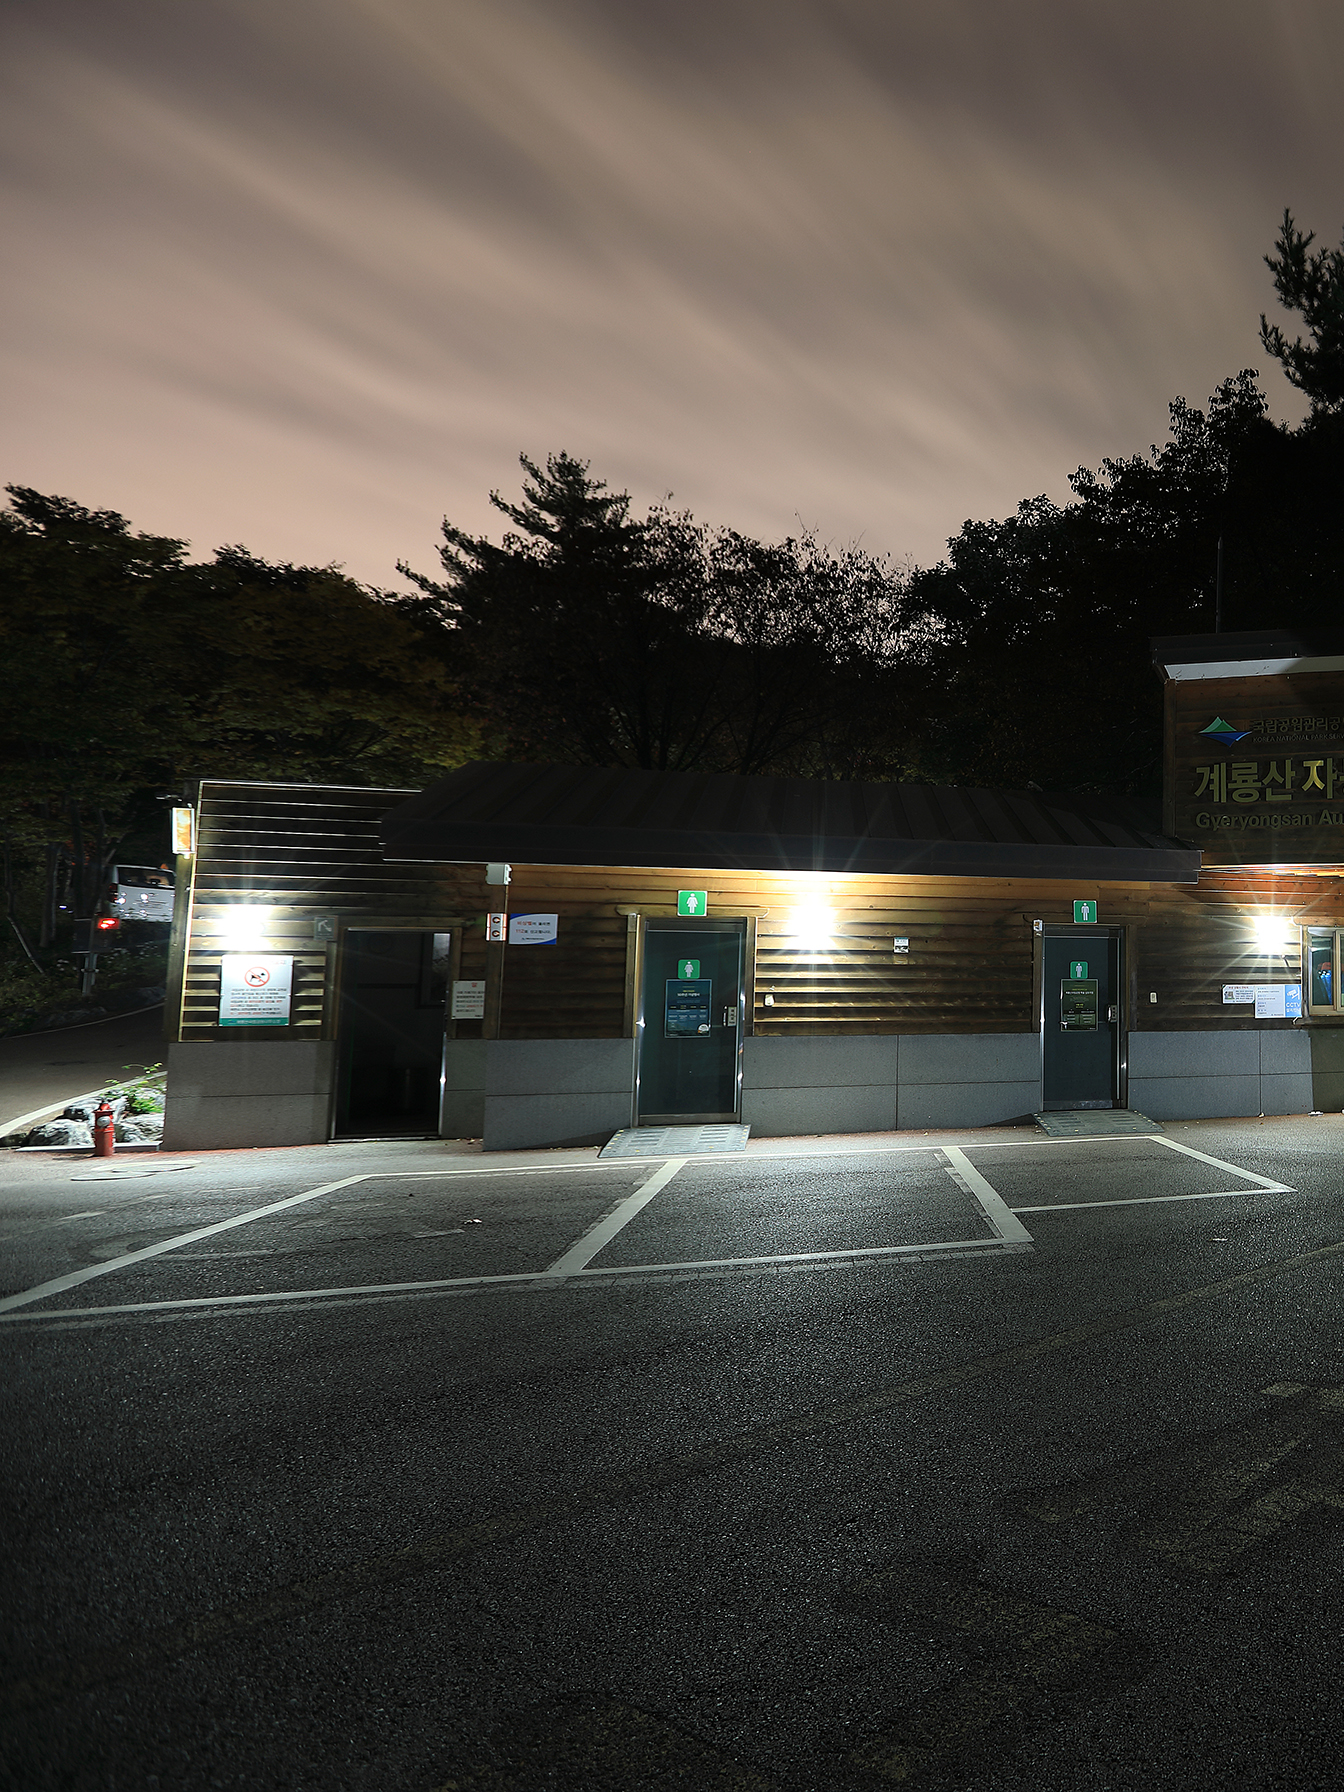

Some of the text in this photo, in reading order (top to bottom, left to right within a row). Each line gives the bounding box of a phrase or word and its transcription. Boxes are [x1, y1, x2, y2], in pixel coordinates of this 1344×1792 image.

[1253, 735, 1276, 743] KOREA
[1276, 734, 1310, 742] NATIONAL
[1311, 733, 1328, 741] PARK
[1194, 759, 1296, 803] 계룡산
[1195, 811, 1313, 831] Gyeryongsan
